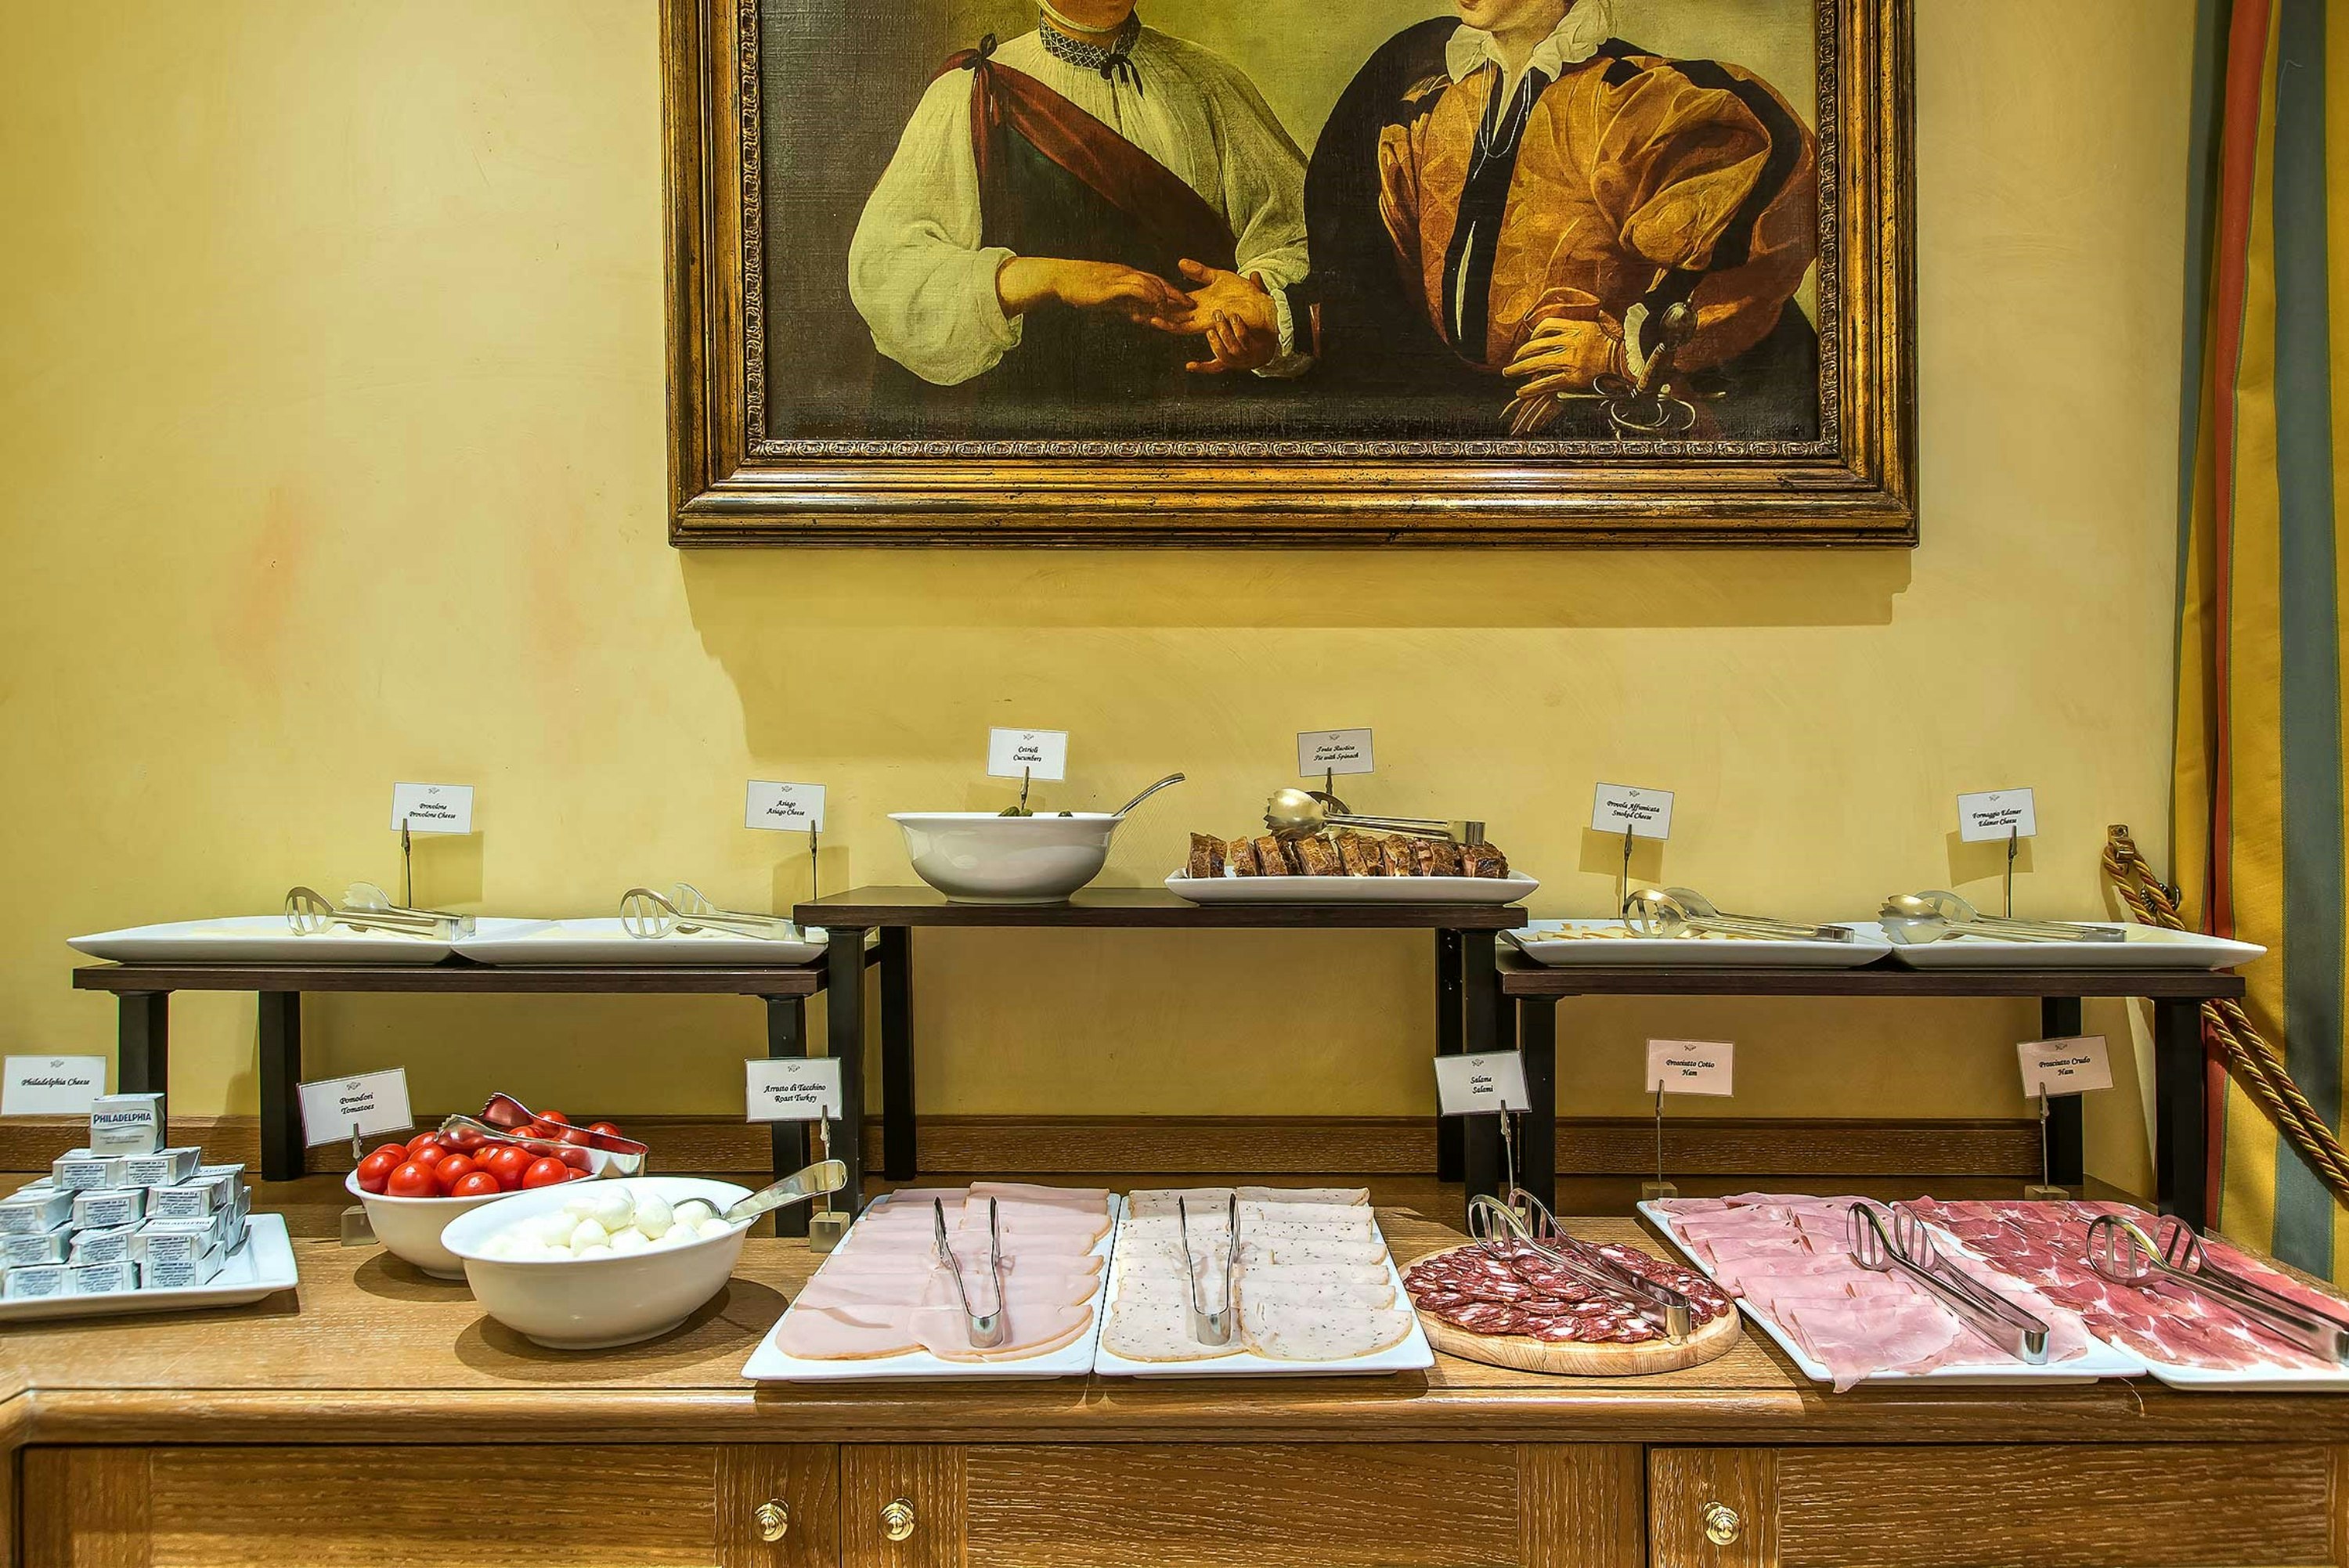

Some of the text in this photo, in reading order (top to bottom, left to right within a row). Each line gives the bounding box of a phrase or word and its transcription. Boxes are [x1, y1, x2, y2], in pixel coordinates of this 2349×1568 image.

[1628, 803, 1660, 813] Affumicata
[2039, 1056, 2091, 1068] Prosciutto Crudo
[21, 1077, 90, 1087] Philadelphia Cheese
[1470, 1076, 1492, 1084] Salame
[1472, 1085, 1494, 1094] Salami
[339, 1092, 373, 1104] Pomodori
[794, 1094, 817, 1103] Turkey
[341, 1104, 374, 1114] Tomatoes
[93, 1112, 152, 1125] PHILADELPHIA
